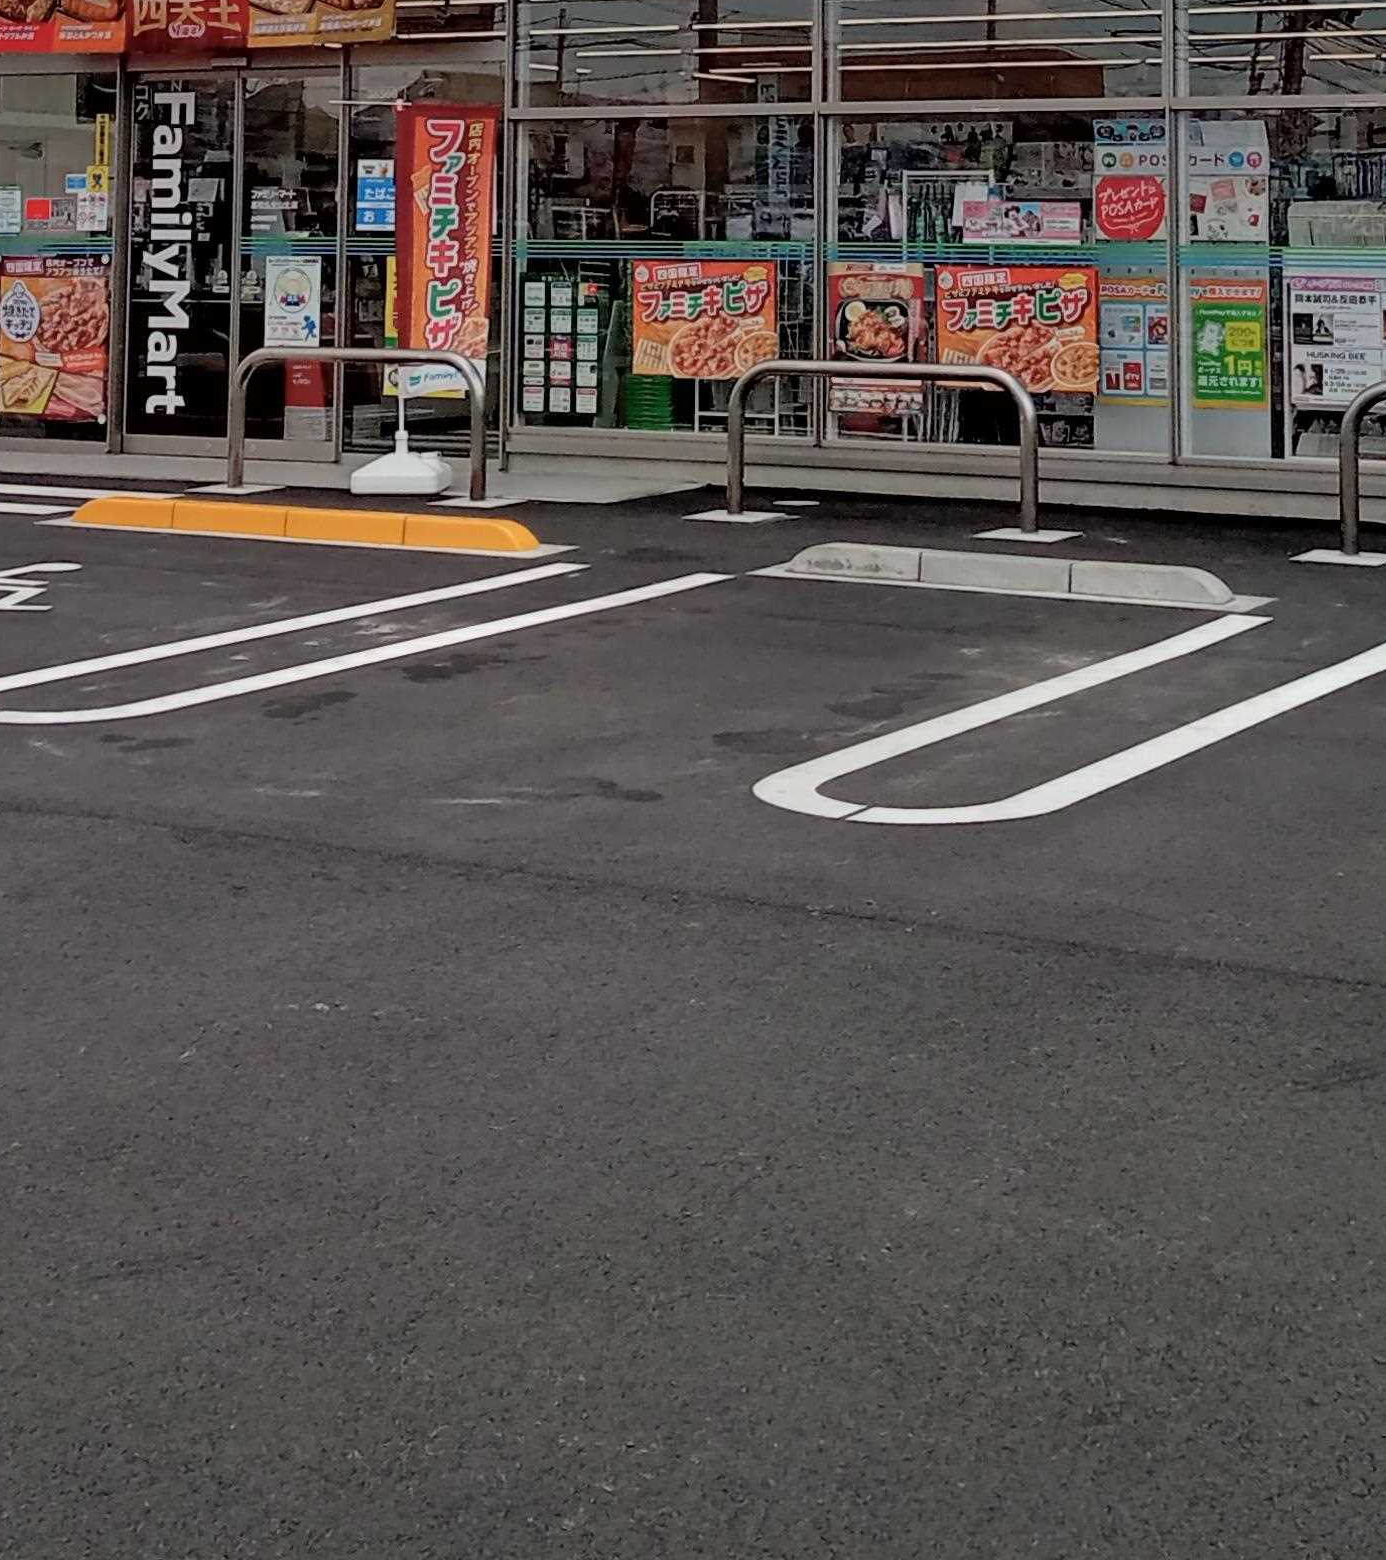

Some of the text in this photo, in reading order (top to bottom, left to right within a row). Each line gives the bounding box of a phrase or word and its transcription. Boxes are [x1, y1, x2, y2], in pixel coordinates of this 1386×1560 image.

[142, 91, 196, 415] FamilyMart
[426, 118, 465, 350] ファミチキピザ
[637, 280, 767, 322] ファミチキピザ
[942, 288, 1088, 331] ファミチキピザ
